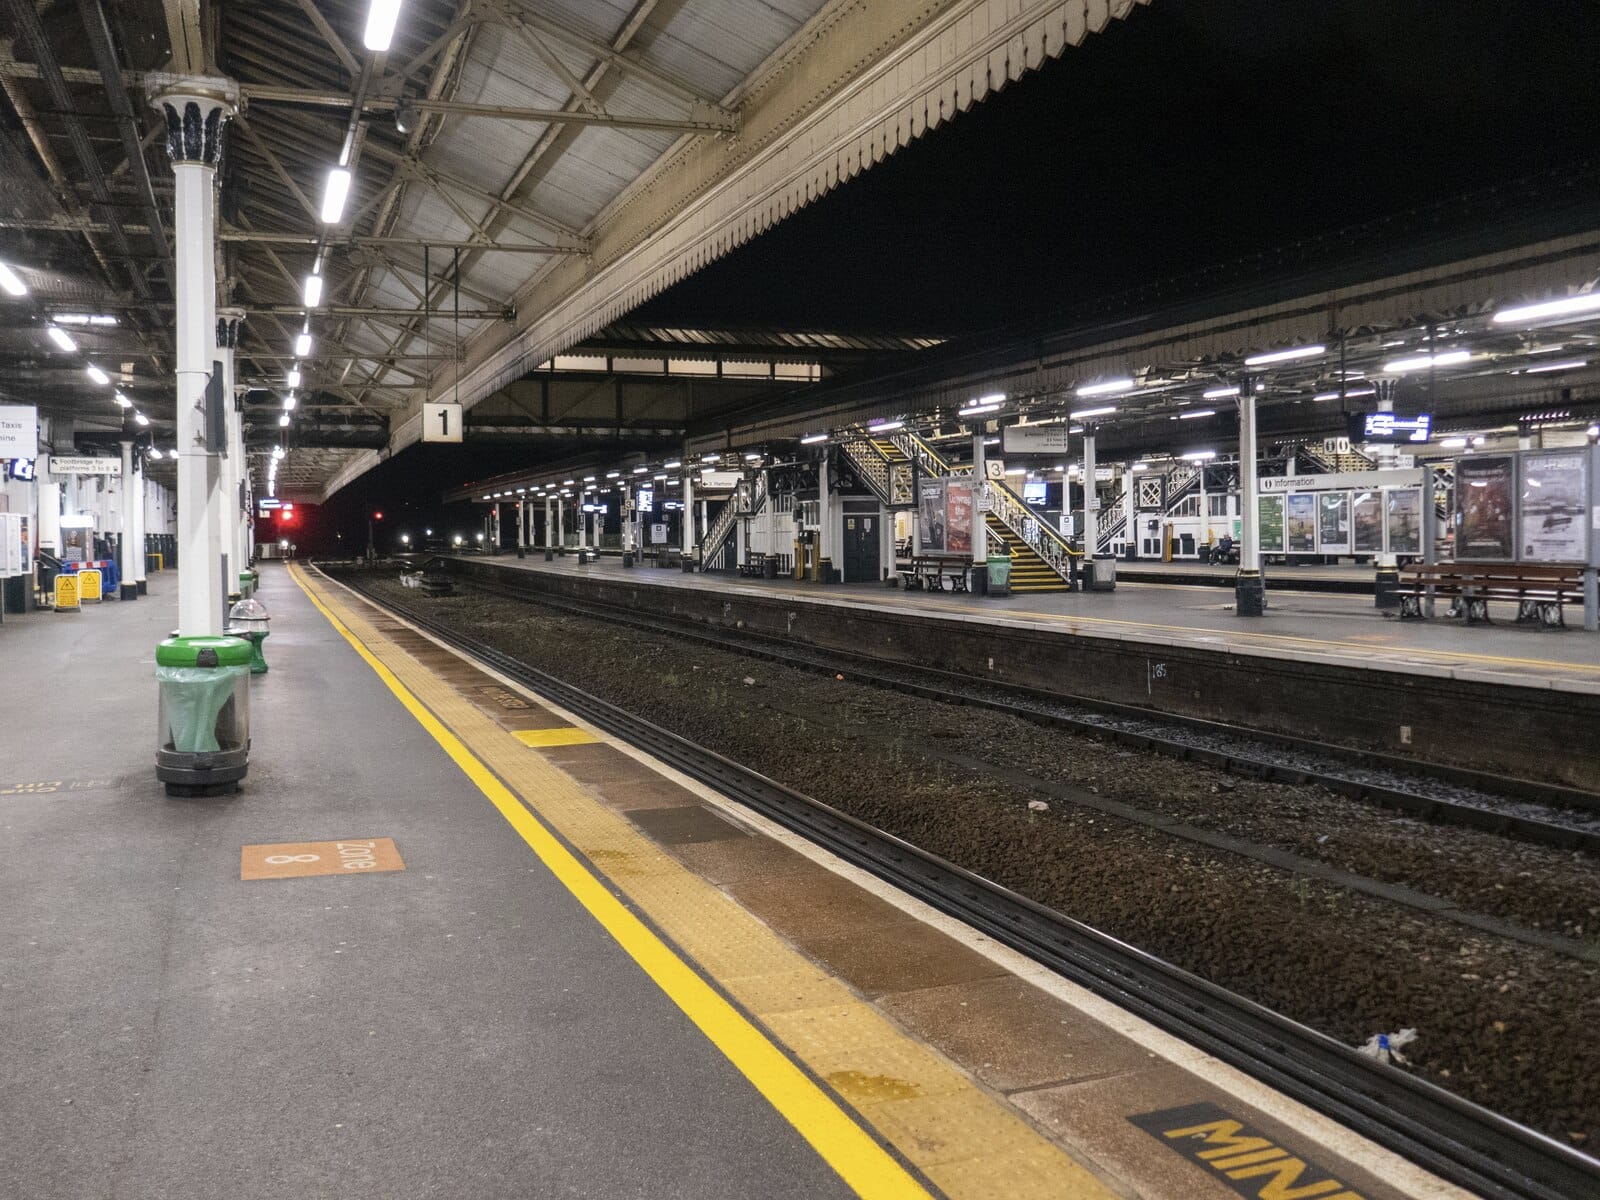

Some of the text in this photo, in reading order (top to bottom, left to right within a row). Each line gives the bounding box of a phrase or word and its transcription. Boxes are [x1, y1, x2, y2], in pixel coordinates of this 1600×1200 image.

[1, 421, 23, 429] Taxis
[438, 409, 448, 436] 1
[991, 463, 1001, 477] 3
[1274, 477, 1315, 488] Information
[265, 854, 321, 865] 8
[336, 841, 377, 870] Zone
